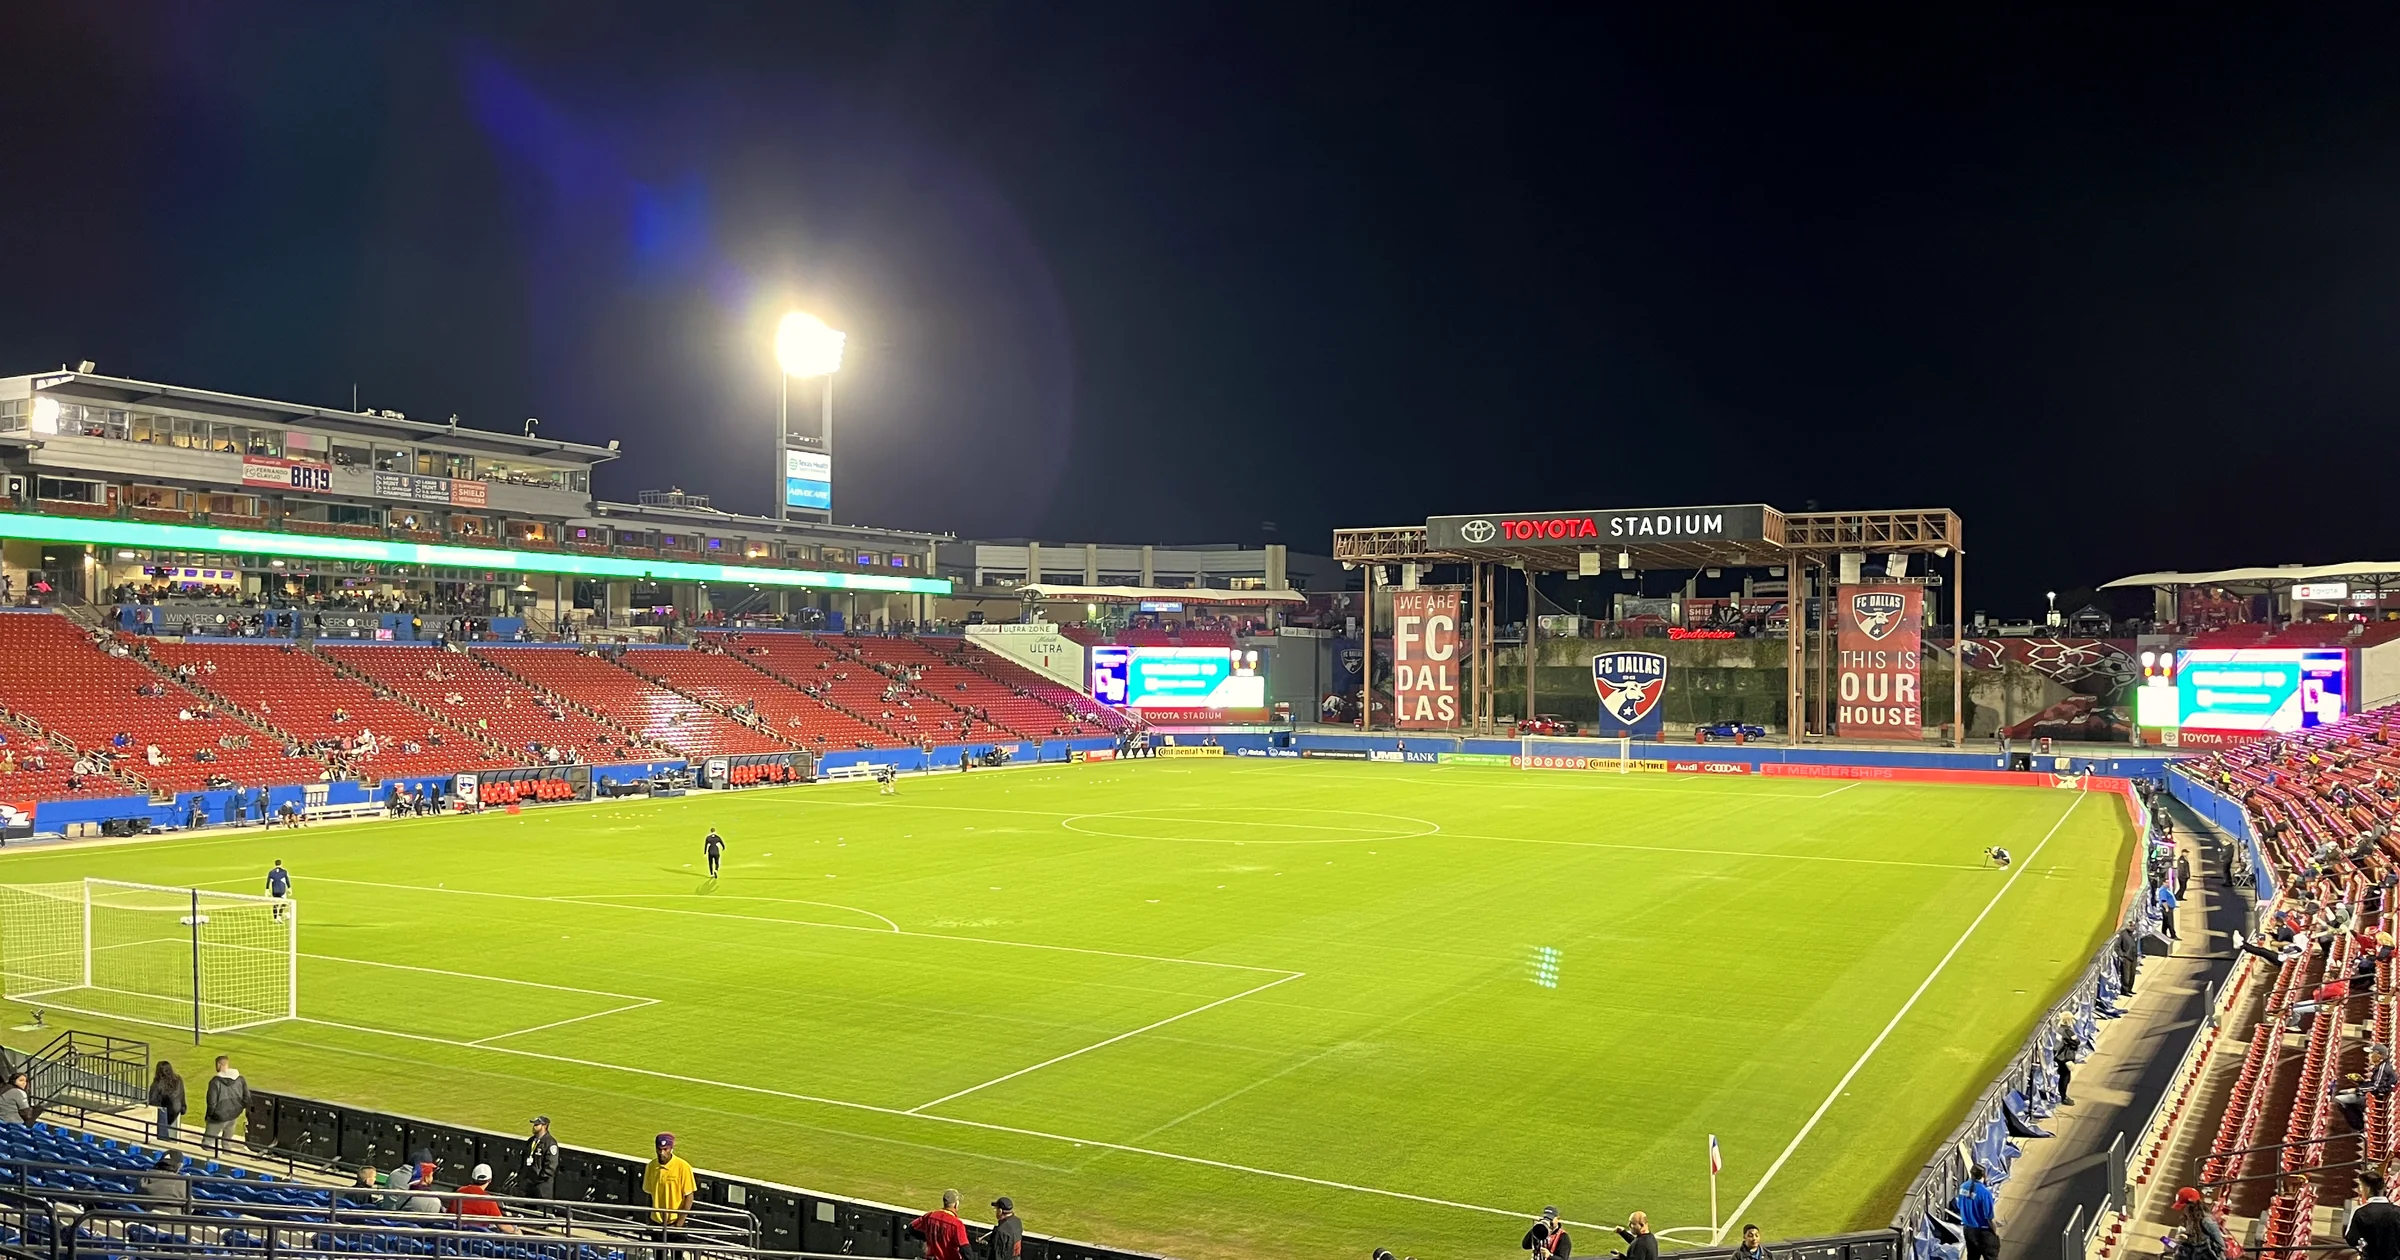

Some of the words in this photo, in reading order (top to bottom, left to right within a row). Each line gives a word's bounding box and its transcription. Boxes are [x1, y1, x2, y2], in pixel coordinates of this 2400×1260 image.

[256, 467, 288, 476] FERNANDO
[459, 489, 485, 498] SHIELD
[459, 496, 485, 504] WINNERS
[1501, 518, 1598, 540] TOYOTA
[1610, 514, 1723, 536] STADIUM
[1400, 596, 1422, 609] WE
[1426, 595, 1455, 608] ARE
[1856, 597, 1867, 608] FC
[1869, 595, 1901, 608] DALLAS
[166, 613, 214, 623] WINNERS
[303, 617, 347, 627] WINERS
[1029, 625, 1051, 633] ZONE
[1668, 627, 1736, 640] Budweiser
[1397, 615, 1454, 662] FC
[1030, 644, 1062, 653] ULTRA
[1841, 650, 1886, 669] THIS
[1897, 651, 1916, 669] IS
[1599, 657, 1613, 675] FC
[1617, 656, 1661, 675] DALLAS
[1397, 665, 1454, 691] DAL
[1840, 672, 1915, 702] OUR
[1397, 694, 1455, 721] LAS
[1145, 712, 1180, 720] TOYOTA
[1183, 712, 1222, 720] STADIUM
[1840, 706, 1916, 726] HOUSE
[2182, 733, 2222, 744] TOYOTA
[1407, 753, 1435, 762] BANK
[1589, 758, 1636, 769] Contineal
[1675, 763, 1698, 771] Audi
[1788, 766, 1893, 778] MEMBERSHIPS
[2096, 779, 2127, 790] 2023
